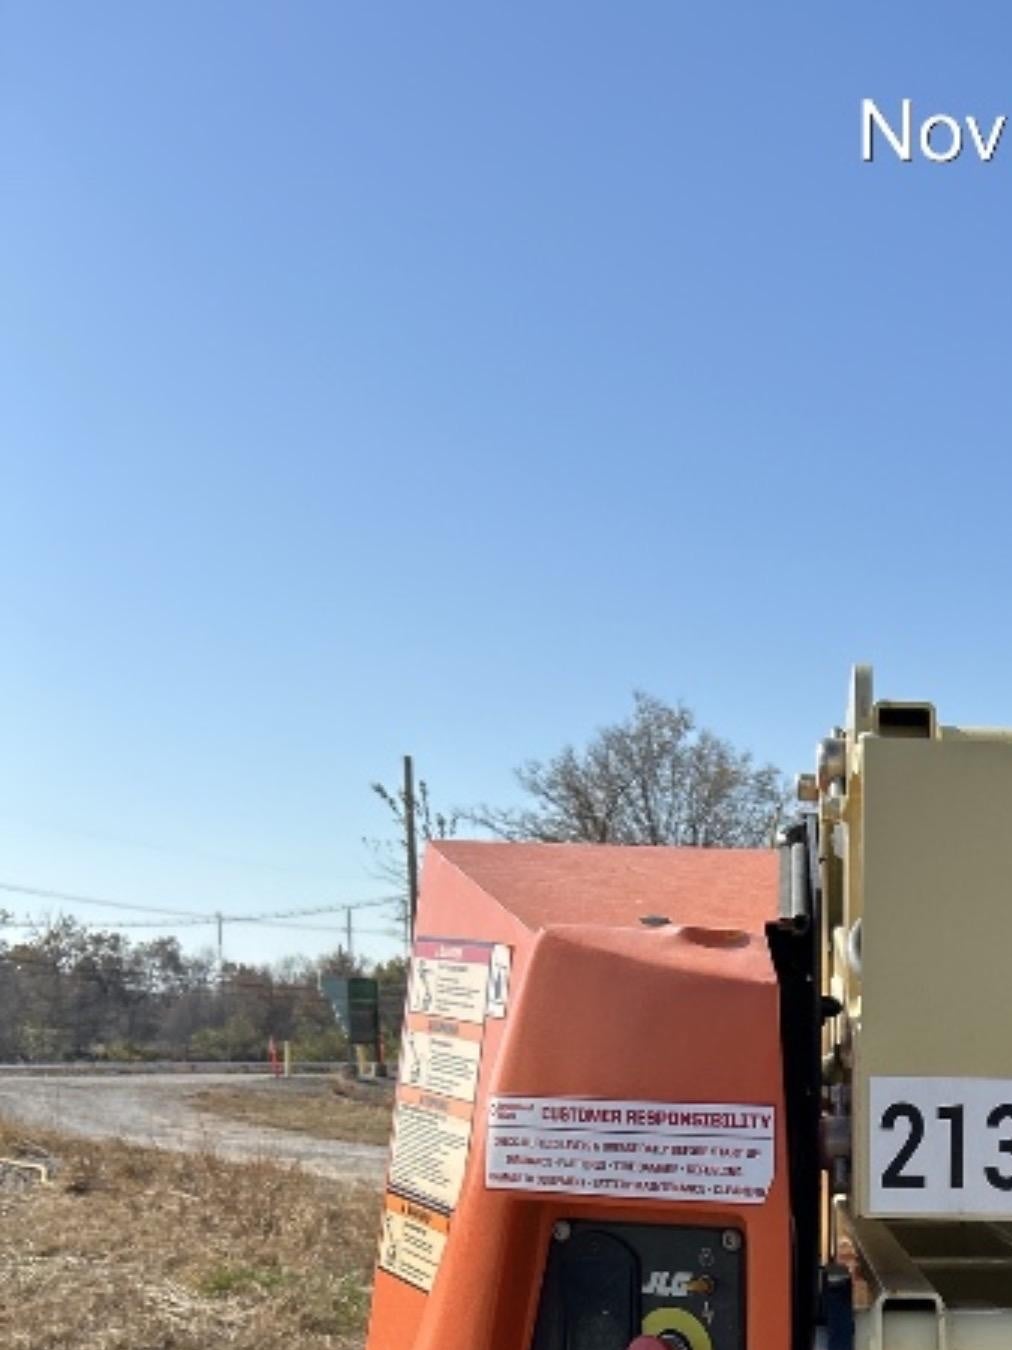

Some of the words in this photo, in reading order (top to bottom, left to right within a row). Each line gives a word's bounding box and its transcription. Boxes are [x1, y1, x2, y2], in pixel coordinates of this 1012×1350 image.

[541, 1105, 622, 1125] CUSTOMER
[626, 1108, 772, 1129] RESPONSIBILITY
[641, 1271, 693, 1297] JLG
